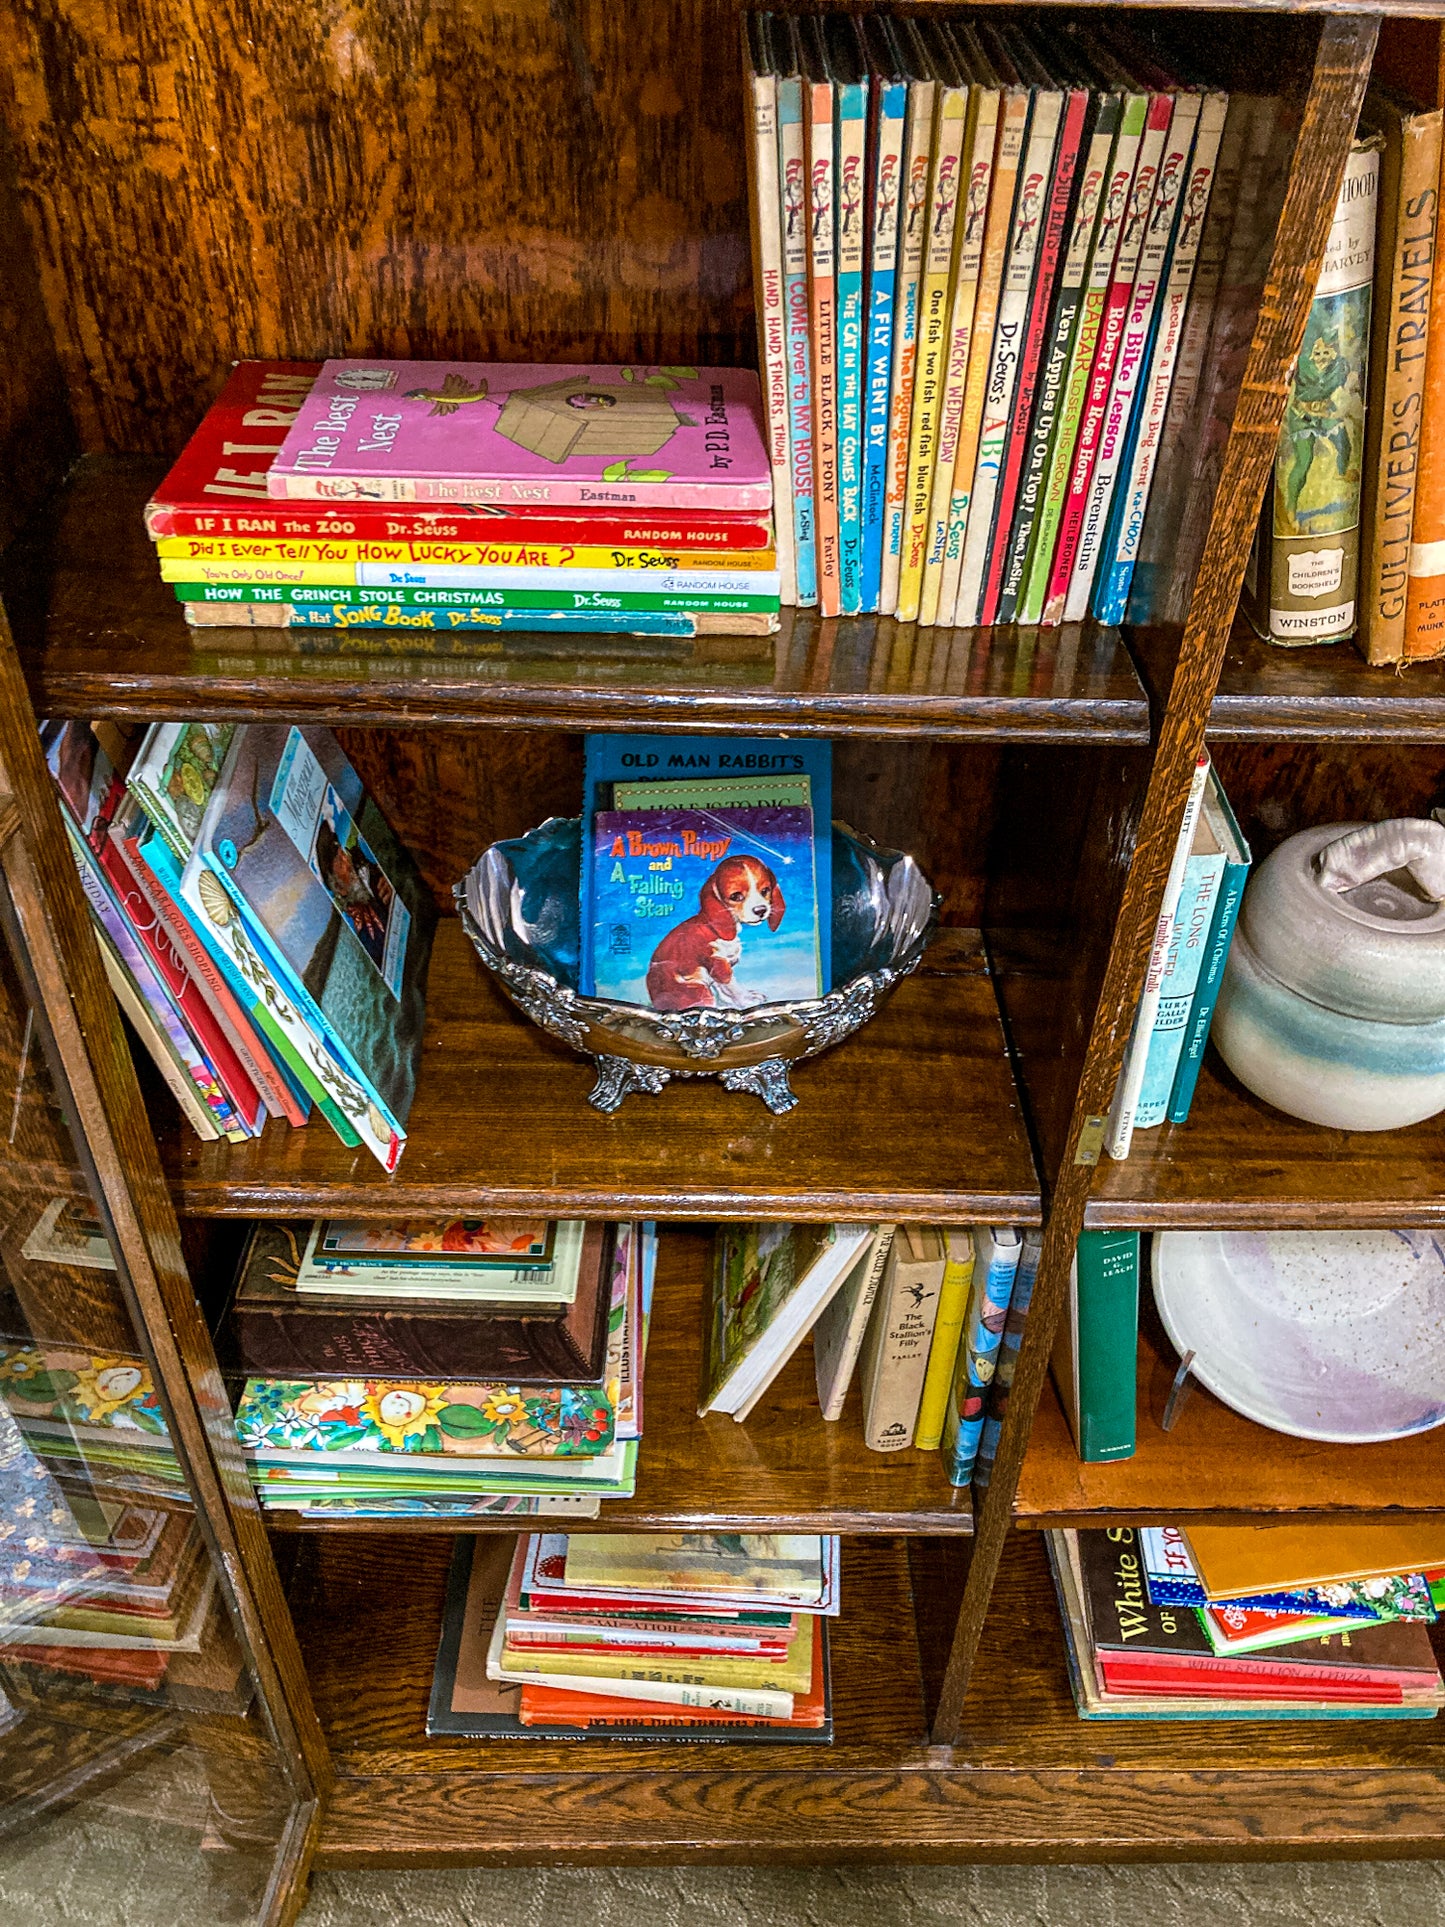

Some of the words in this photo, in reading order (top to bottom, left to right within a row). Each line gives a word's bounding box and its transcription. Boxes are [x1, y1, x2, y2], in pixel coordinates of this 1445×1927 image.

[1342, 172, 1375, 204] HOOD
[1349, 237, 1360, 250] by
[764, 270, 779, 309] HAND,
[1394, 188, 1437, 373] TRAVELS
[789, 281, 808, 335] COME
[844, 292, 858, 318] THE
[876, 291, 891, 305] A
[932, 290, 943, 315] One
[1131, 279, 1155, 324] The
[767, 317, 782, 356] HAND,
[819, 300, 831, 364] LITTLE
[843, 323, 858, 349] CAT
[875, 313, 890, 347] FLY
[928, 318, 941, 344] fish
[1056, 305, 1076, 342] Ten
[1073, 292, 1104, 373] BABAR
[1097, 306, 1125, 371] Robert
[1163, 293, 1182, 353] Because
[792, 342, 805, 377] over
[844, 353, 856, 368] IN
[927, 352, 937, 375] two
[948, 327, 968, 381] WACKY
[1118, 331, 1144, 382] Bike
[769, 361, 784, 419] FINGERS,
[793, 381, 807, 400] to
[844, 373, 857, 398] THE
[871, 355, 888, 416] WENT
[923, 380, 936, 403] fish
[1042, 346, 1067, 412] Apples
[1092, 376, 1107, 400] the
[1151, 373, 1170, 416] Little
[313, 394, 360, 433] Best
[821, 374, 832, 436] BLACK,
[1065, 378, 1083, 422] LOSES
[794, 405, 811, 433] MY
[843, 403, 857, 431] HAT
[921, 412, 932, 432] red
[940, 386, 963, 463] WEDNESDAY
[1037, 415, 1054, 440] Up
[1083, 404, 1104, 446] Rose
[1102, 388, 1132, 461] Lesson
[357, 413, 403, 453] Nest
[773, 424, 786, 466] THUMB
[870, 424, 886, 447] BY
[919, 434, 932, 457] fish
[1059, 428, 1073, 449] HIS
[1141, 421, 1159, 448] Bug
[292, 435, 341, 473] The
[794, 438, 812, 497] HOUSE
[842, 437, 857, 481] COMES
[1031, 446, 1048, 470] On
[822, 461, 834, 503] PONY
[916, 465, 929, 489] blue
[1051, 453, 1067, 501] CROWN
[1073, 447, 1094, 495] Horse
[1136, 454, 1150, 486] went
[428, 483, 457, 497] The
[463, 484, 502, 498] Best
[511, 485, 551, 499] Nest
[580, 489, 637, 502] Eastman
[843, 487, 858, 522] BACK
[869, 464, 880, 525] McClintock
[914, 492, 927, 515] fish
[1022, 472, 1042, 513] Top!
[1380, 393, 1421, 620] GULLIVER'S
[196, 518, 216, 531] IF
[223, 518, 232, 531] I
[238, 518, 276, 532] RAN
[283, 521, 311, 533] The
[318, 521, 356, 534] ZOO
[389, 522, 412, 535] Dr.
[413, 521, 458, 536] Seuss
[624, 529, 683, 541] RANDOM
[686, 530, 729, 542] HOUSE
[1078, 473, 1113, 571] Berenstains
[189, 542, 214, 556] Did
[219, 543, 227, 555] I
[232, 544, 272, 557] Ever
[275, 544, 310, 558] Tell
[611, 552, 635, 567] Dr.
[639, 553, 680, 568] Seuss
[824, 536, 835, 577] Farley
[928, 520, 948, 565] LeSieg
[1059, 511, 1078, 579] HEILBRONER
[1291, 579, 1340, 590] BOOKSHELF
[1292, 568, 1340, 580] CHILDREN'S
[204, 588, 243, 600] HOW
[251, 588, 283, 600] THE
[290, 588, 351, 601] GRINCH
[359, 590, 406, 602] STOLE
[413, 590, 504, 605] CHRISTMAS
[573, 594, 593, 607] Dr.
[592, 593, 622, 608] Seuss
[663, 599, 709, 608] RANDOM
[713, 600, 749, 608] HOUSE
[1279, 612, 1346, 628] WINSTON
[1417, 621, 1445, 632] MUNK
[621, 753, 659, 768] OLD
[668, 754, 710, 768] MAN
[718, 754, 804, 769] RABBIT'S
[1182, 801, 1195, 834] BRETT
[610, 836, 626, 859] A
[627, 830, 681, 858] Brown
[681, 830, 732, 860] Puppy
[610, 861, 626, 884] A
[648, 857, 672, 871] and
[629, 874, 684, 900] Falling
[1195, 871, 1216, 903] THE
[634, 897, 674, 918] Star
[148, 878, 174, 911] CARL
[167, 910, 192, 941] GOES
[184, 940, 224, 993] SHOPPING
[1155, 913, 1173, 949] Trouble
[1186, 906, 1208, 949] LONG
[1146, 967, 1162, 993] Trolls
[1207, 948, 1224, 984] Christmas
[1189, 1039, 1202, 1059] Engel
[1120, 1111, 1131, 1142] PUTNAM
[1103, 1252, 1133, 1265] DAVID
[1103, 1264, 1133, 1277] LEACH
[899, 1321, 925, 1331] Black
[904, 1313, 923, 1322] The
[889, 1329, 932, 1340] Stallion's
[899, 1338, 921, 1348] Filly
[1162, 1527, 1183, 1546] YO
[1164, 1550, 1188, 1568] IF
[1113, 1552, 1149, 1641] White
[1161, 1612, 1177, 1634] OF
[1236, 1664, 1299, 1678] STALLION
